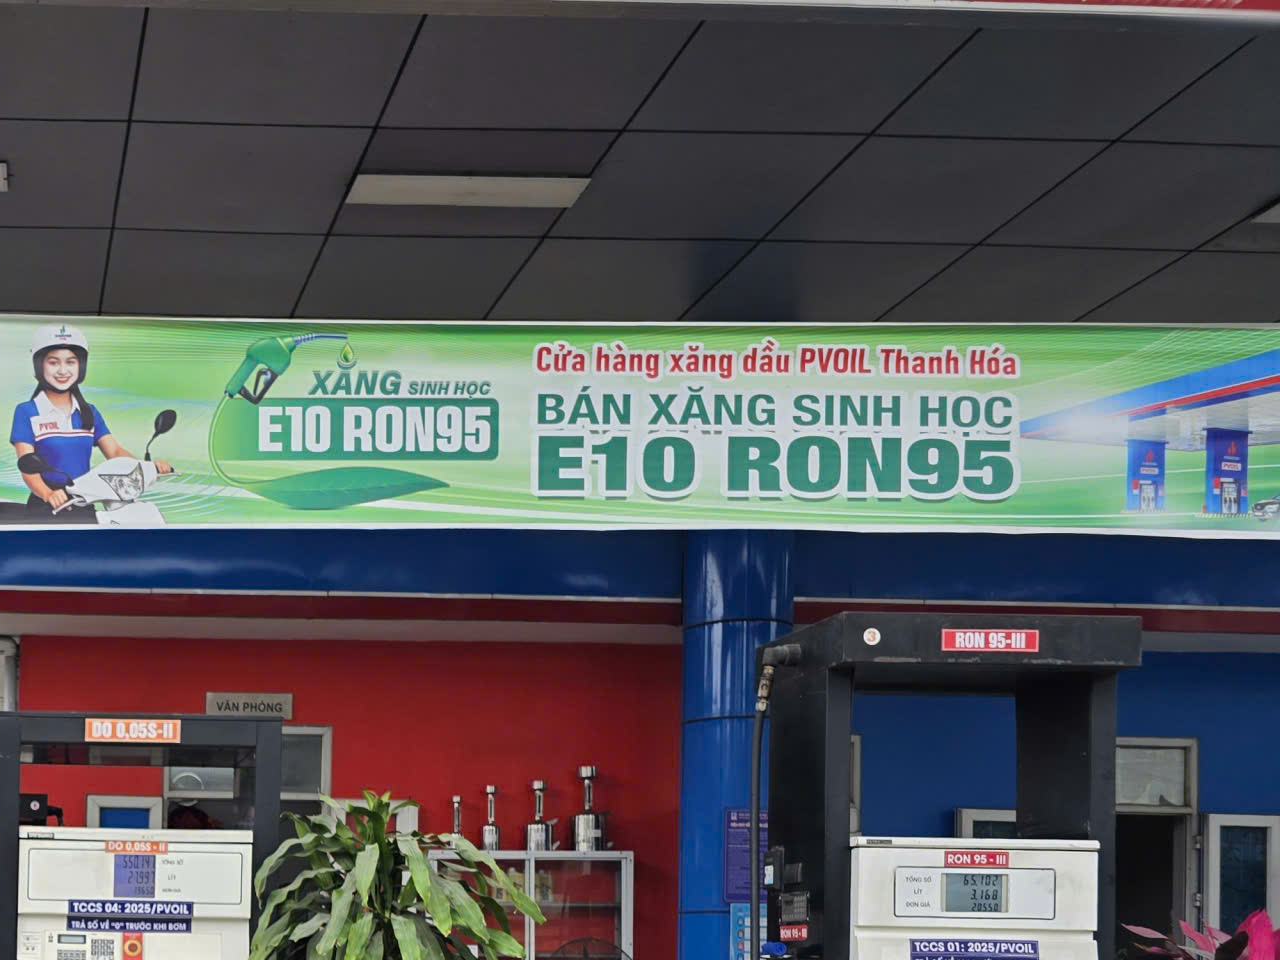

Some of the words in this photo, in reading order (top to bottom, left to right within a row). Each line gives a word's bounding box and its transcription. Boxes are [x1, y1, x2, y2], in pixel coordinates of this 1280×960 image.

[536, 344, 585, 373] Cửa
[595, 344, 659, 379] hàng
[670, 345, 733, 379] xăng
[743, 339, 790, 373] dầu
[800, 348, 872, 374] PVOIL
[880, 348, 960, 375] Thanh
[969, 346, 1018, 376] Hóa
[308, 361, 403, 396] XĂNG
[407, 382, 449, 396] SINH
[453, 381, 492, 399] HỌC
[536, 386, 632, 426] BÁN
[648, 385, 777, 427] XĂNG
[792, 393, 901, 427] SINH
[920, 395, 1013, 437] HỌC
[258, 405, 332, 453] E10
[343, 405, 492, 453] RON95
[537, 434, 697, 493] E10
[727, 435, 1016, 496] RON95
[955, 632, 985, 648] RON
[988, 632, 1026, 649] 95-III
[216, 699, 239, 712] VĂN
[243, 700, 283, 713] PHÒNG
[92, 721, 112, 738] DO
[108, 841, 124, 850] DO
[947, 855, 970, 864] RON
[973, 855, 987, 864] 95
[996, 855, 1007, 865] III
[73, 902, 102, 913] TCCS
[105, 902, 122, 913] 04:
[124, 902, 189, 915] 2025/PVOIL
[87, 919, 99, 929] SỐ
[153, 922, 167, 931] KHI
[914, 941, 944, 952] TCCS
[947, 942, 965, 952] 01:
[967, 942, 1035, 954] 2025/PVOIL
